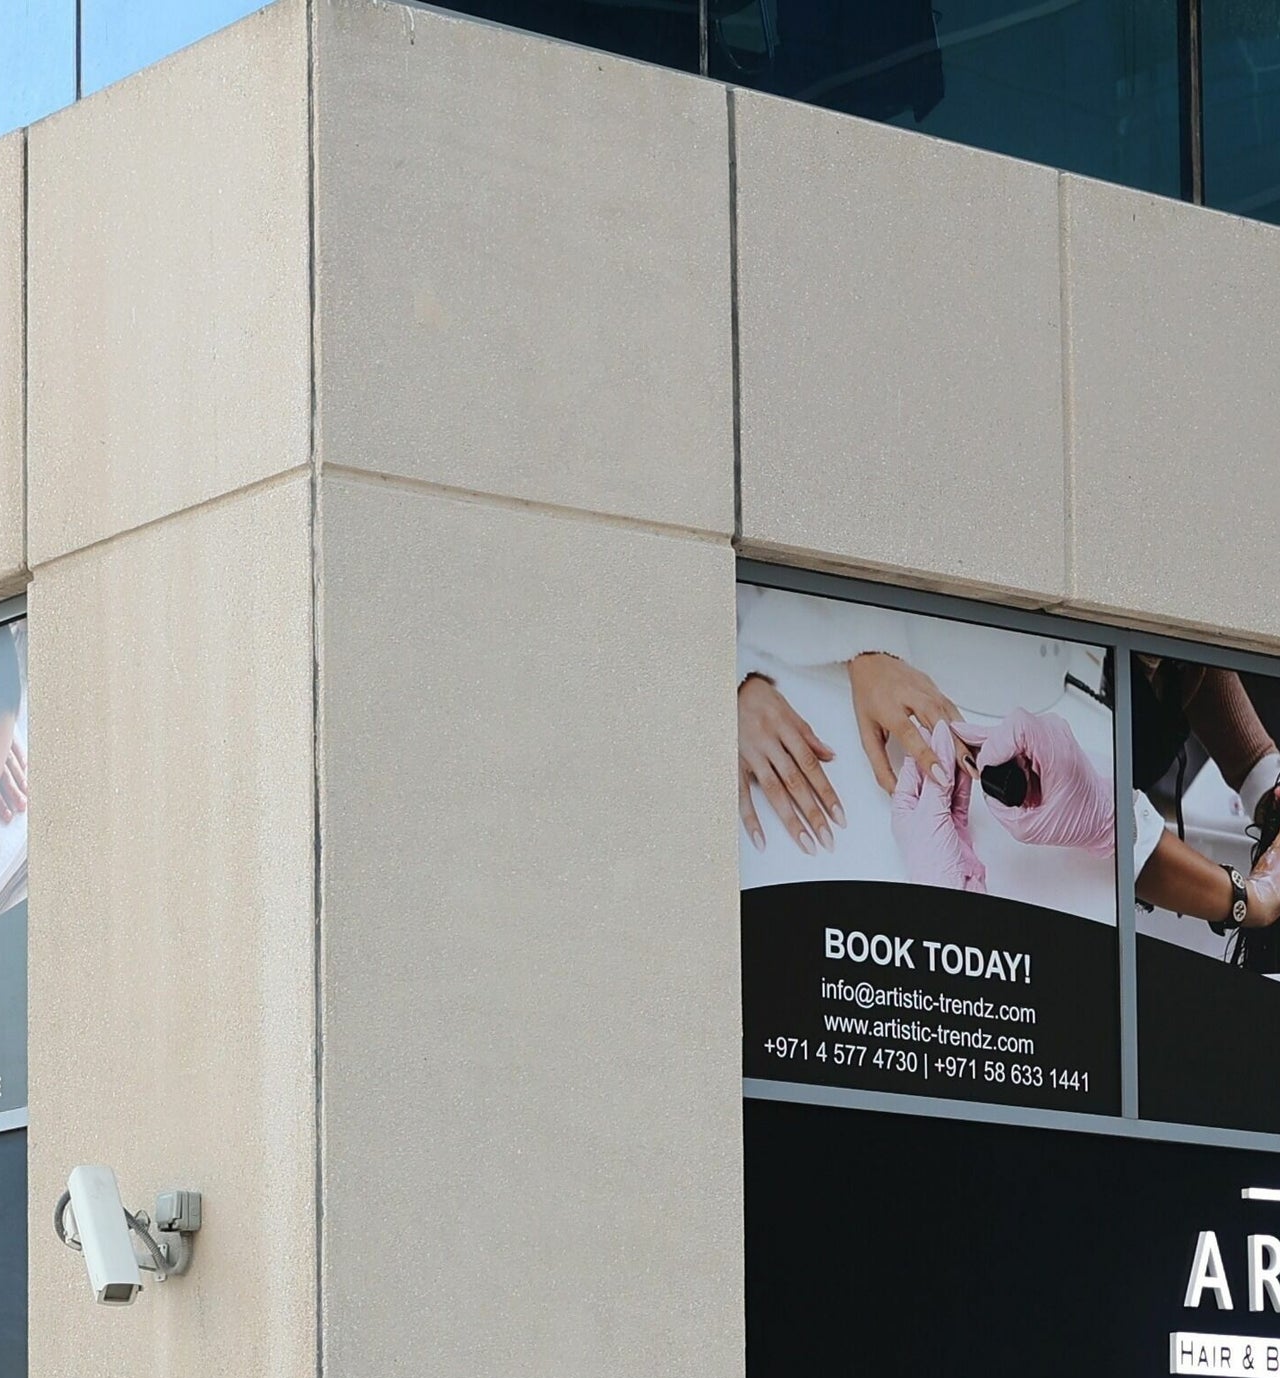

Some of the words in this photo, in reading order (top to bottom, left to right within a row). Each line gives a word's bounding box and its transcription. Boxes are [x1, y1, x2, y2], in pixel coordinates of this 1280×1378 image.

[826, 928, 914, 968] BOOK
[923, 941, 1030, 983] TODAY!
[822, 978, 1035, 1023] info@artistic-trendz.com
[824, 1015, 1033, 1054] www.artistic-trendz.com
[764, 1037, 807, 1060] +971
[816, 1042, 827, 1062] 4
[834, 1044, 866, 1066] 577
[873, 1048, 917, 1072] 4730
[935, 1057, 975, 1079] +971
[984, 1061, 1005, 1082] 58
[1011, 1064, 1042, 1086] 633
[1050, 1069, 1088, 1092] 1441
[1180, 1340, 1232, 1369] HAIR
[1243, 1345, 1255, 1371] &
